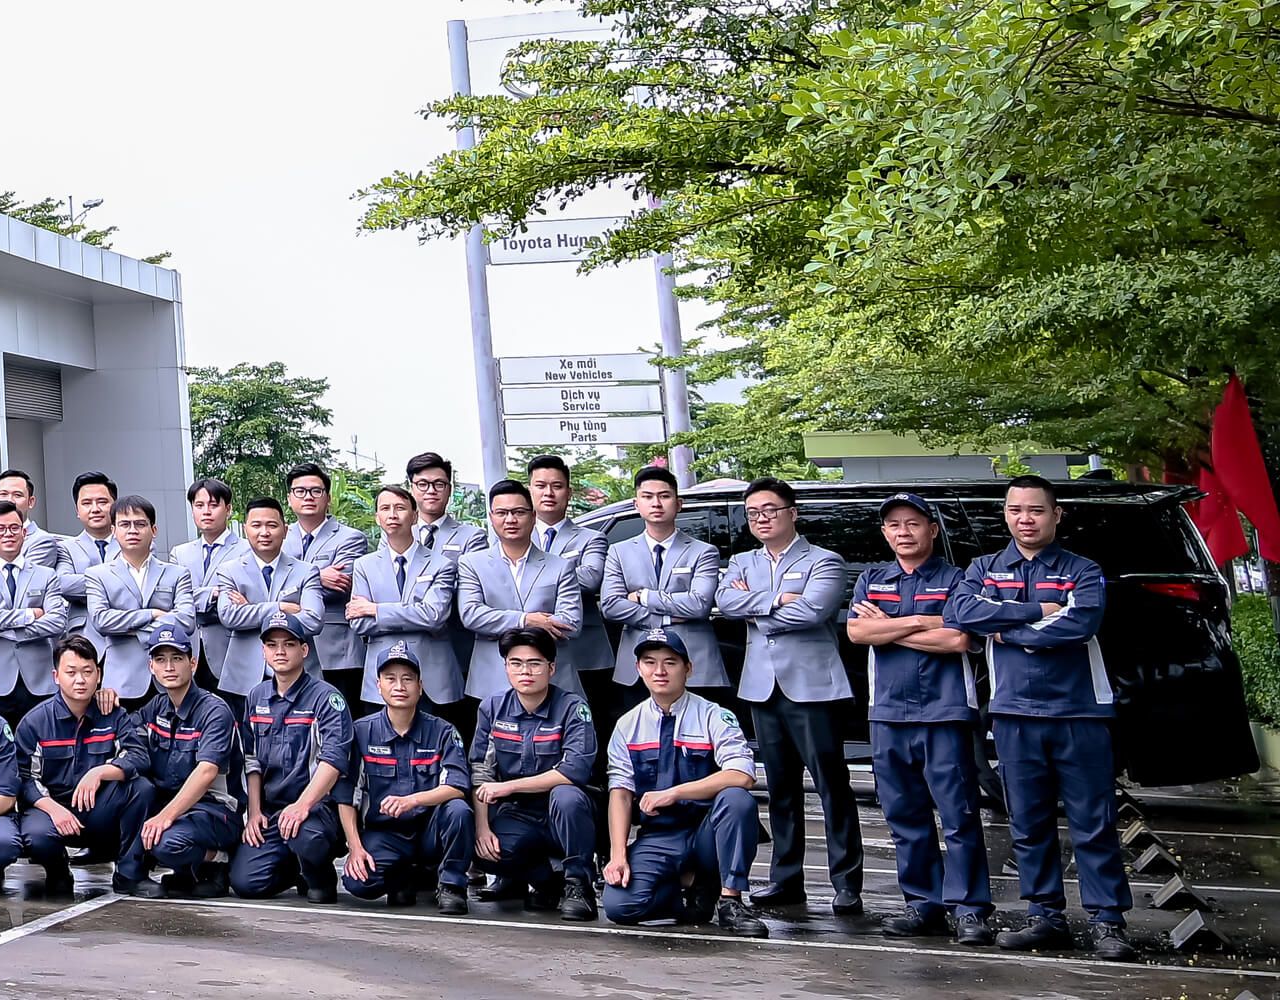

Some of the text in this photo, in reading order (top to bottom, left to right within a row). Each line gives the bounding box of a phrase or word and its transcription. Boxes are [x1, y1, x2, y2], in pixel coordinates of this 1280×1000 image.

[502, 236, 552, 253] Toyota
[559, 357, 597, 370] Xe mới
[545, 370, 613, 381] New Vehicles
[561, 389, 601, 403] Dịch vụ
[562, 401, 601, 411] Service
[559, 419, 607, 434] Phụ tùng
[571, 431, 598, 442] Parts
